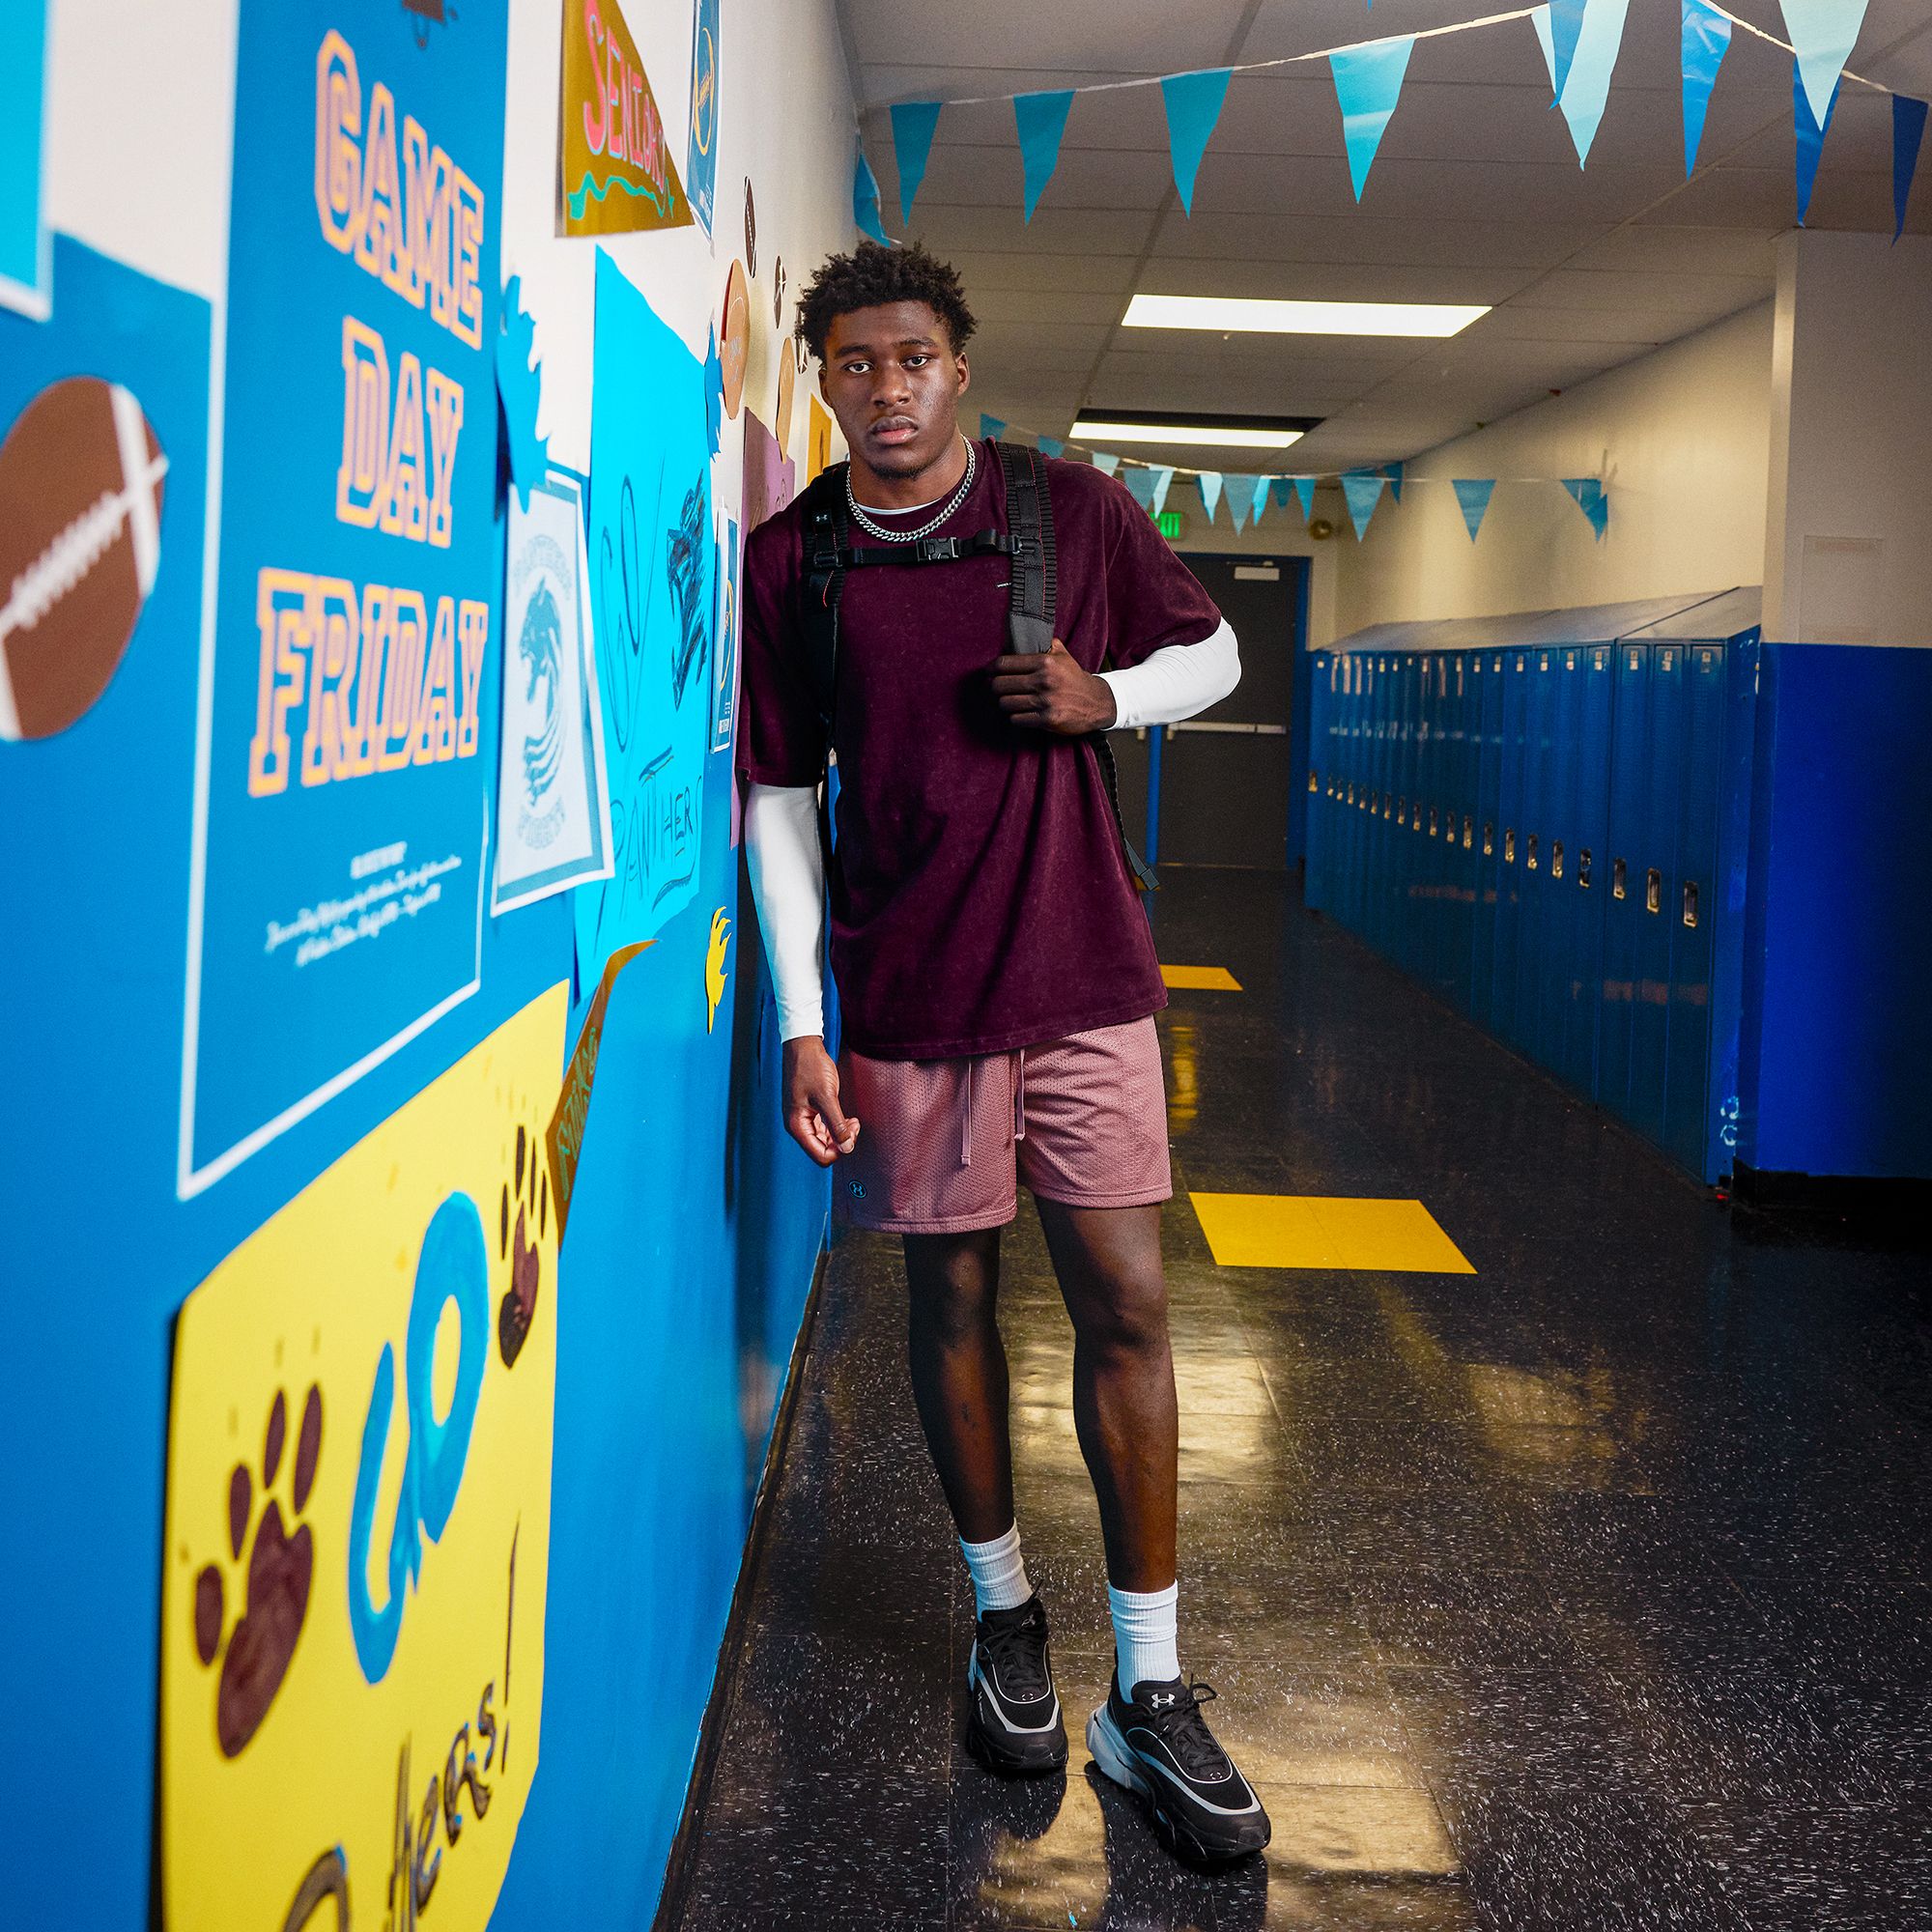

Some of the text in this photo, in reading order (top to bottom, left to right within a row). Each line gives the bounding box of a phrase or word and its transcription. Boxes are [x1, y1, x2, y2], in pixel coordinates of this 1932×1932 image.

[315, 29, 484, 350] GAME
[336, 315, 464, 549] DAY
[248, 567, 489, 798] FRIDAY
[600, 474, 640, 753] GO
